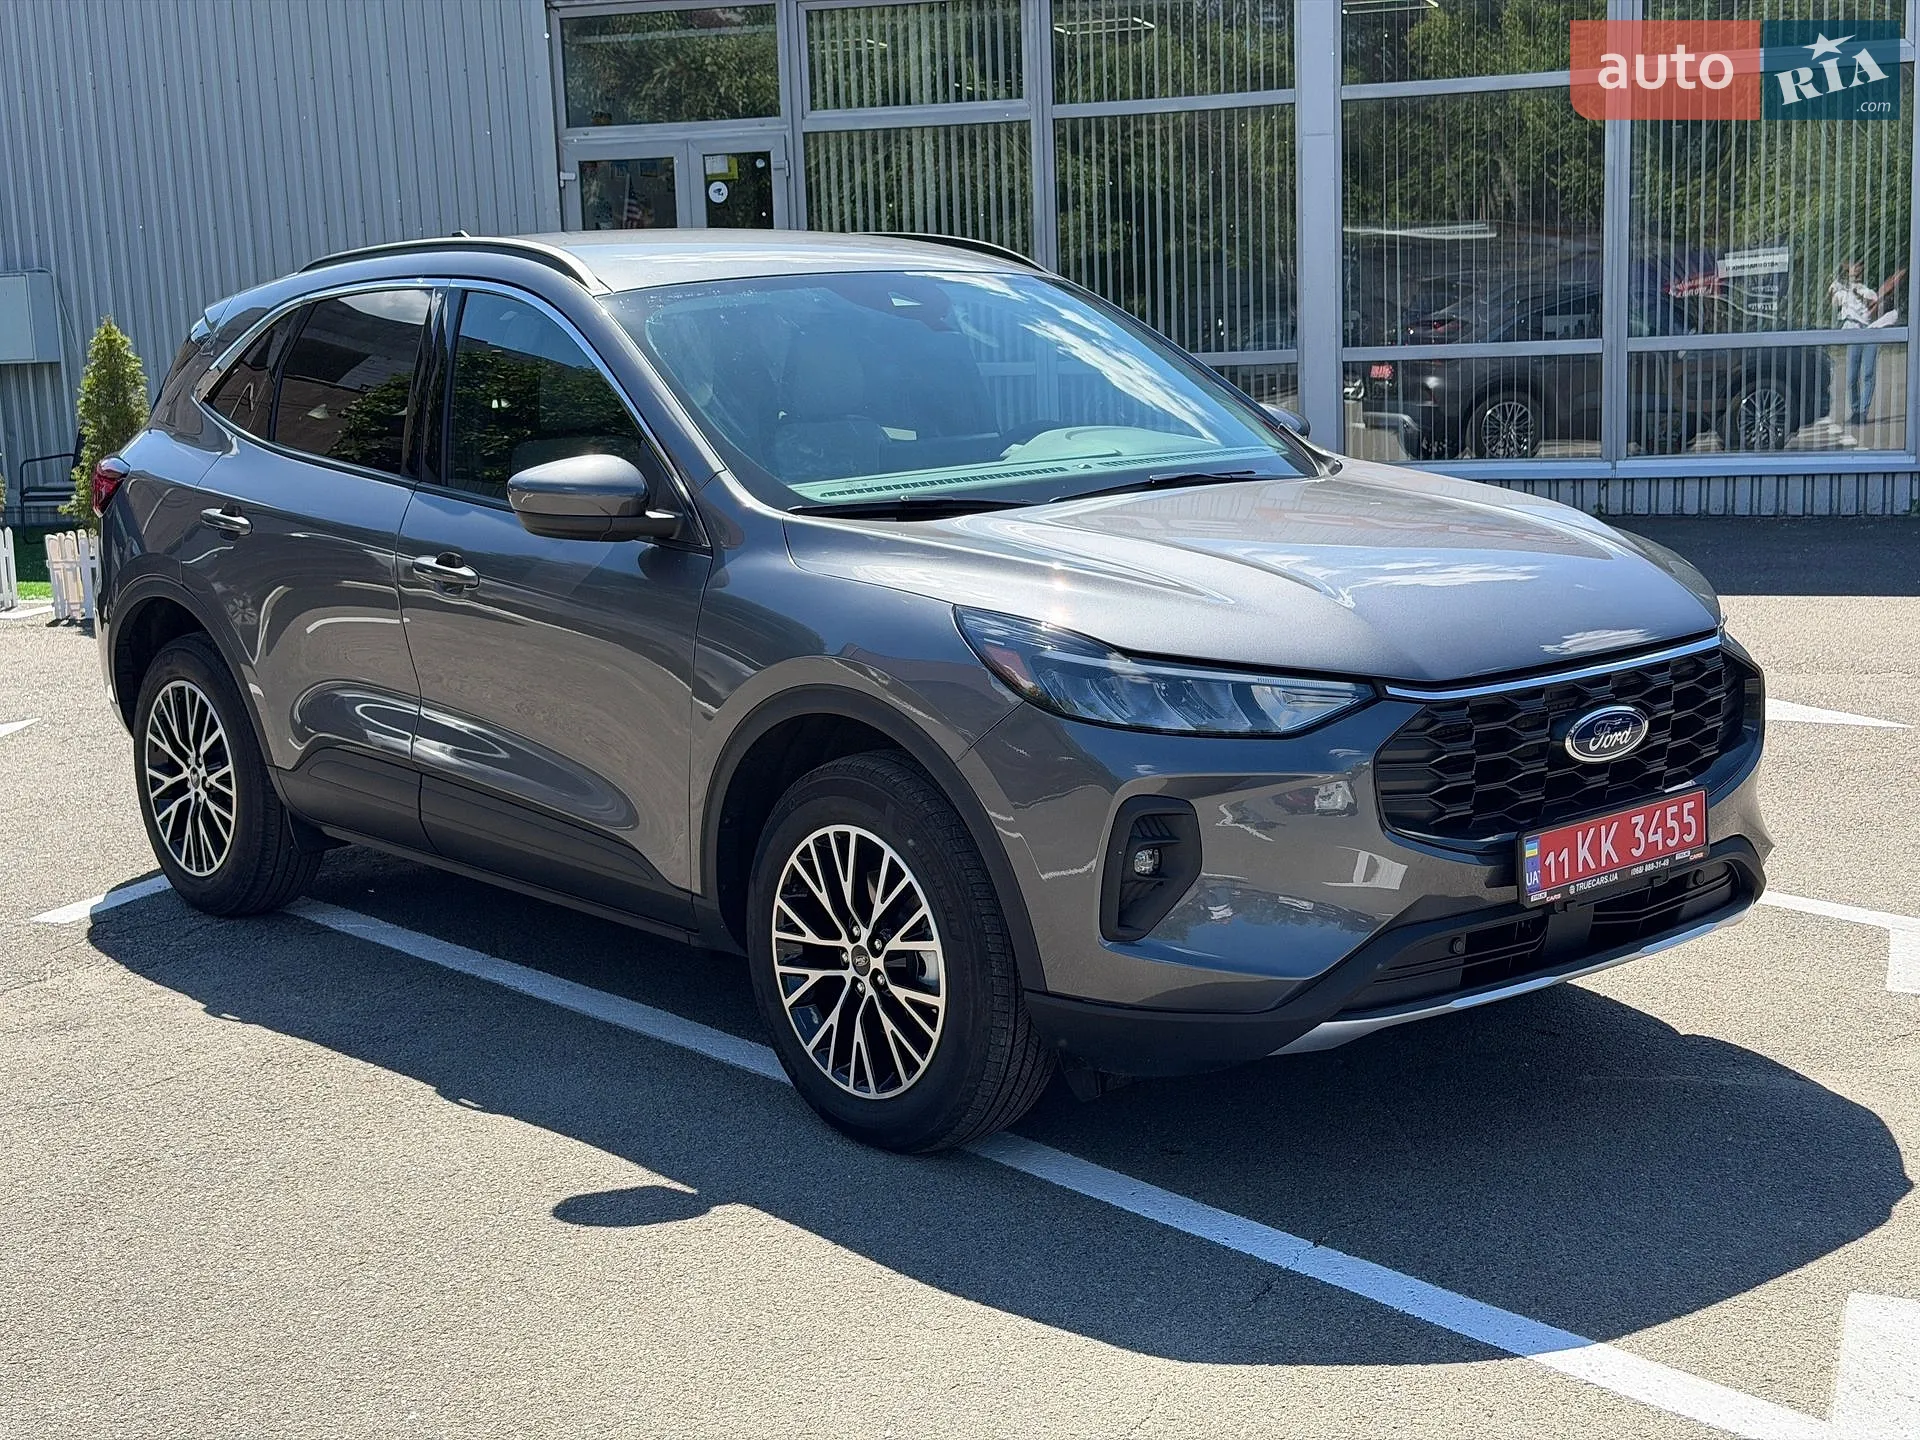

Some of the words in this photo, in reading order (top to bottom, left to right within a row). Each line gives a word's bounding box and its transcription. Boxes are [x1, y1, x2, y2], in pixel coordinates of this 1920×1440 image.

[1589, 717, 1633, 752] Ford
[1630, 801, 1696, 857] 3455
[1526, 870, 1539, 886] UA
